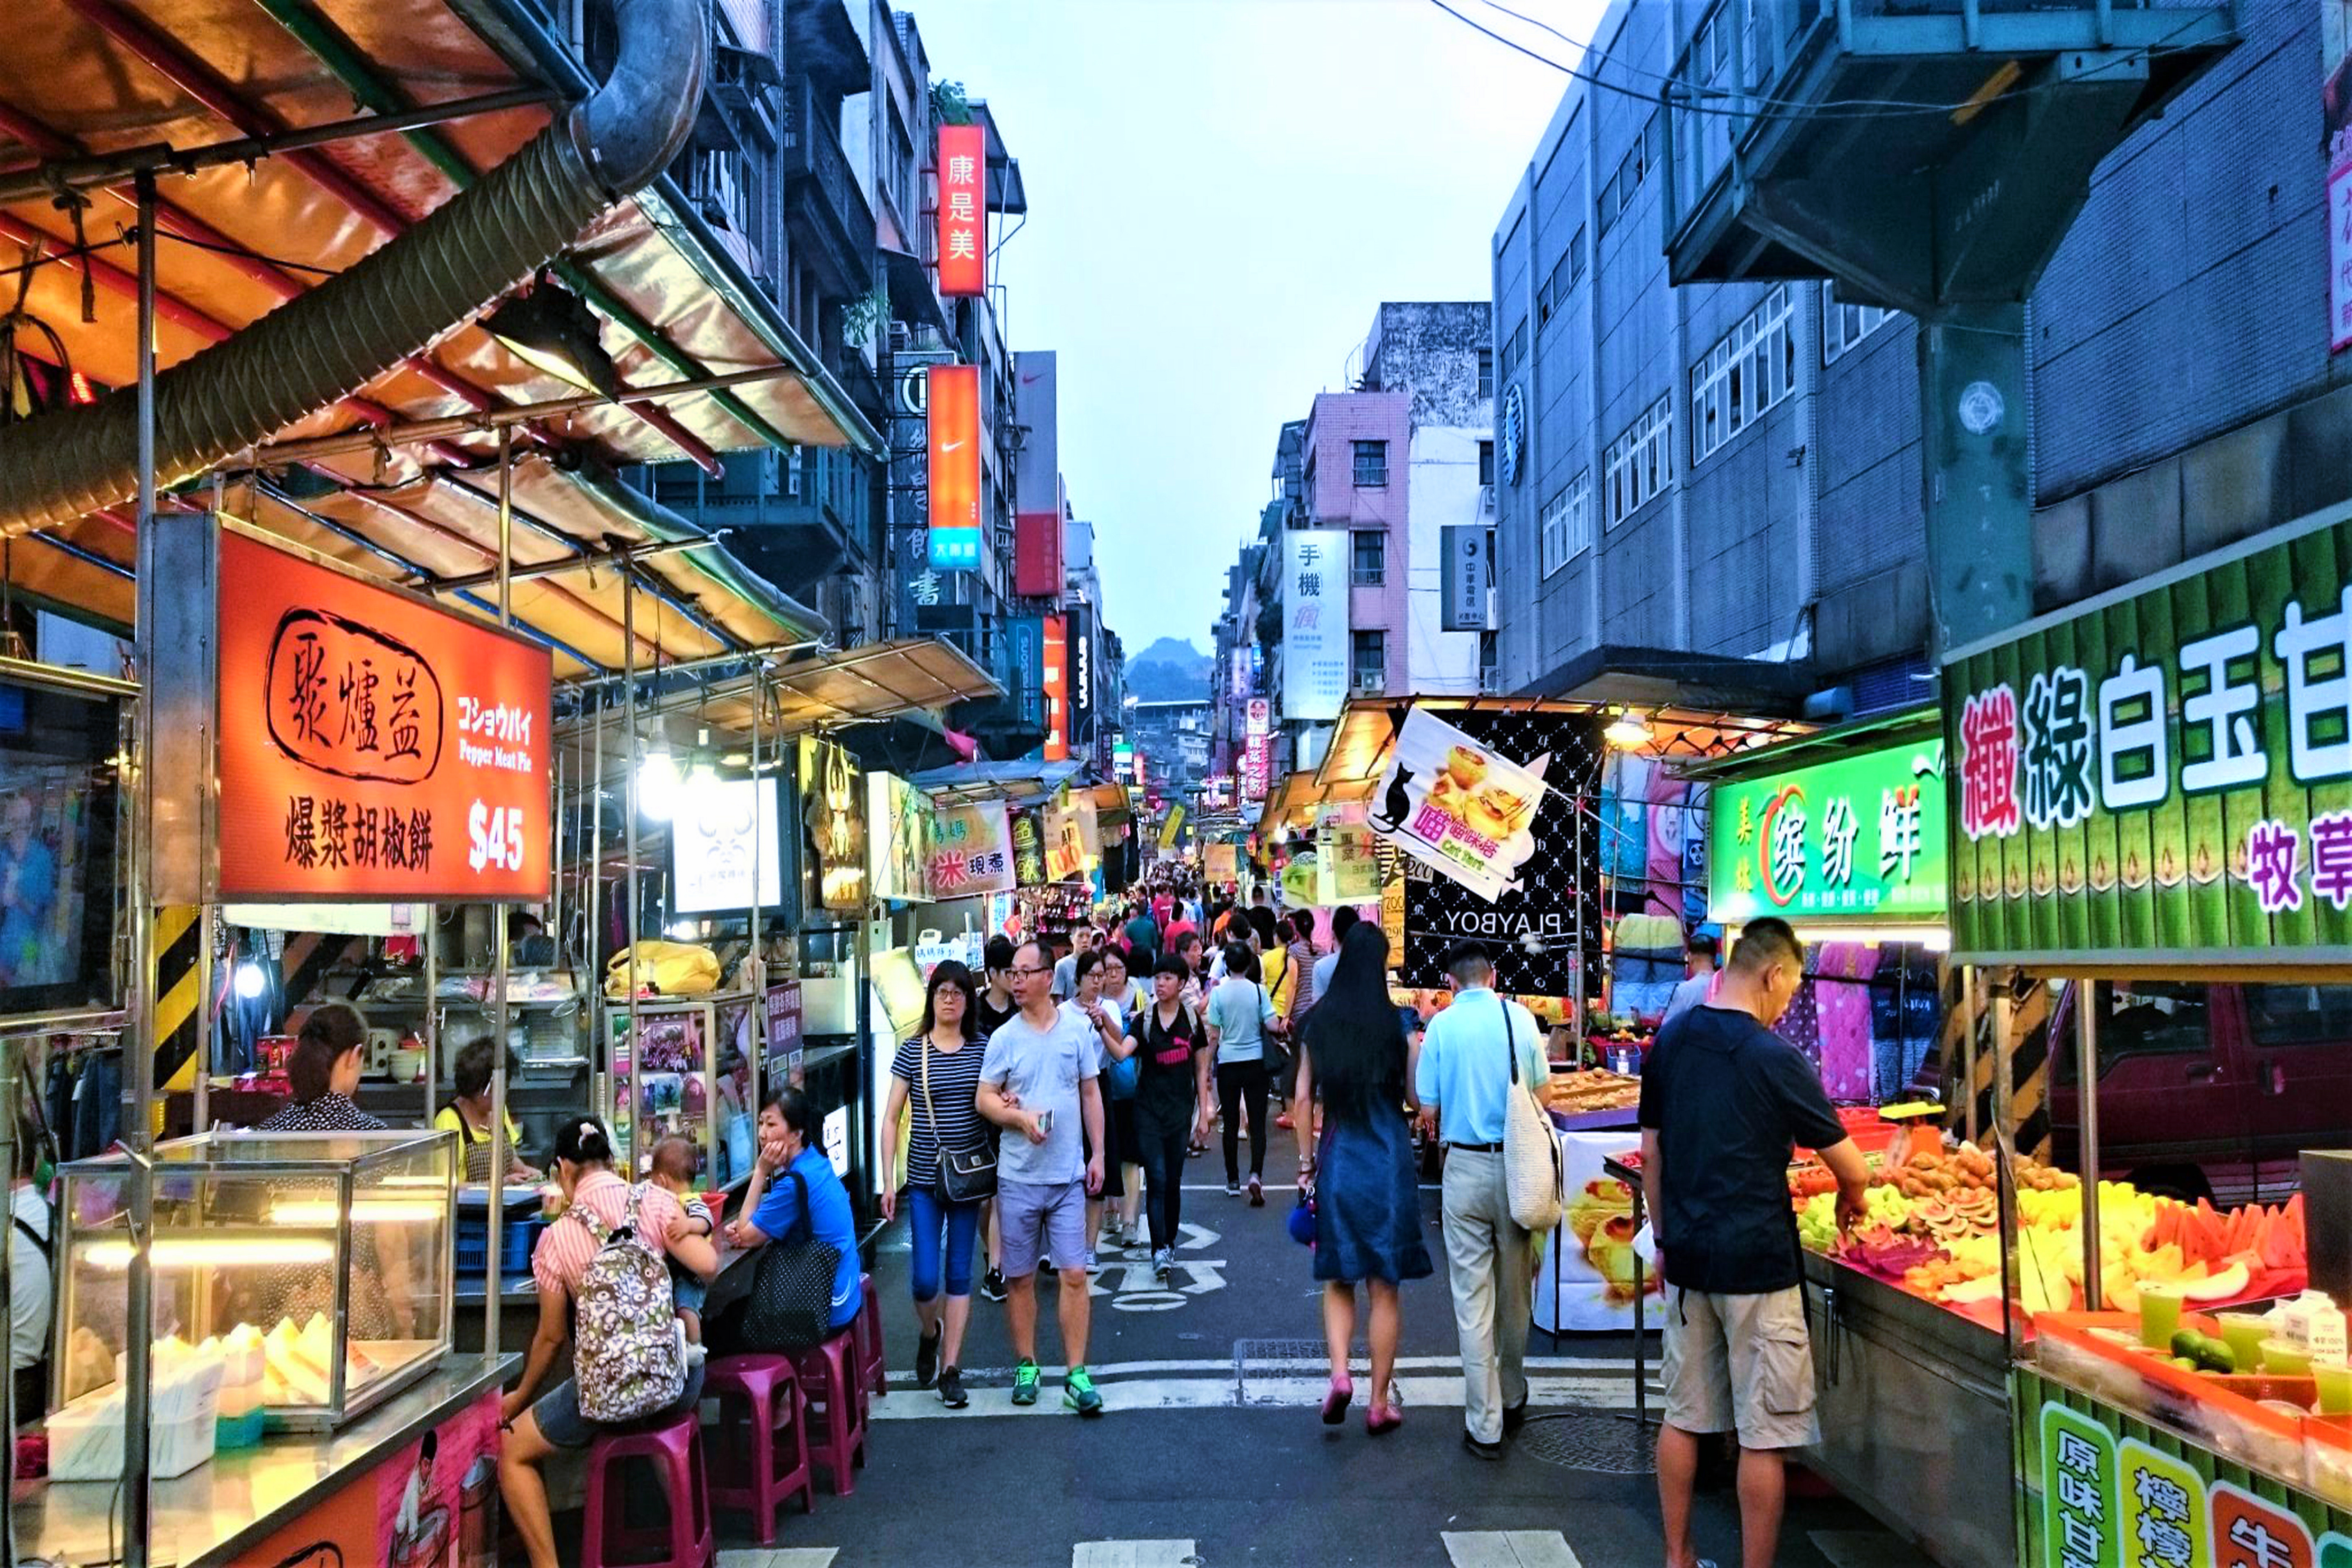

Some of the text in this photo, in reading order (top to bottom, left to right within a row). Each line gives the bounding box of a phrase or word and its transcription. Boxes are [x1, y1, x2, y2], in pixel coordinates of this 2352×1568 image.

[947, 155, 975, 260] 康是美
[458, 696, 533, 746] コショウパイ
[459, 738, 532, 773] Pepper Meat Pie
[284, 795, 433, 873] 爆漿胡椒餅
[468, 798, 523, 873] $45
[2248, 809, 2352, 914] 牧草
[2133, 1466, 2194, 1568] 檸檬
[2230, 1515, 2293, 1568] 牛
